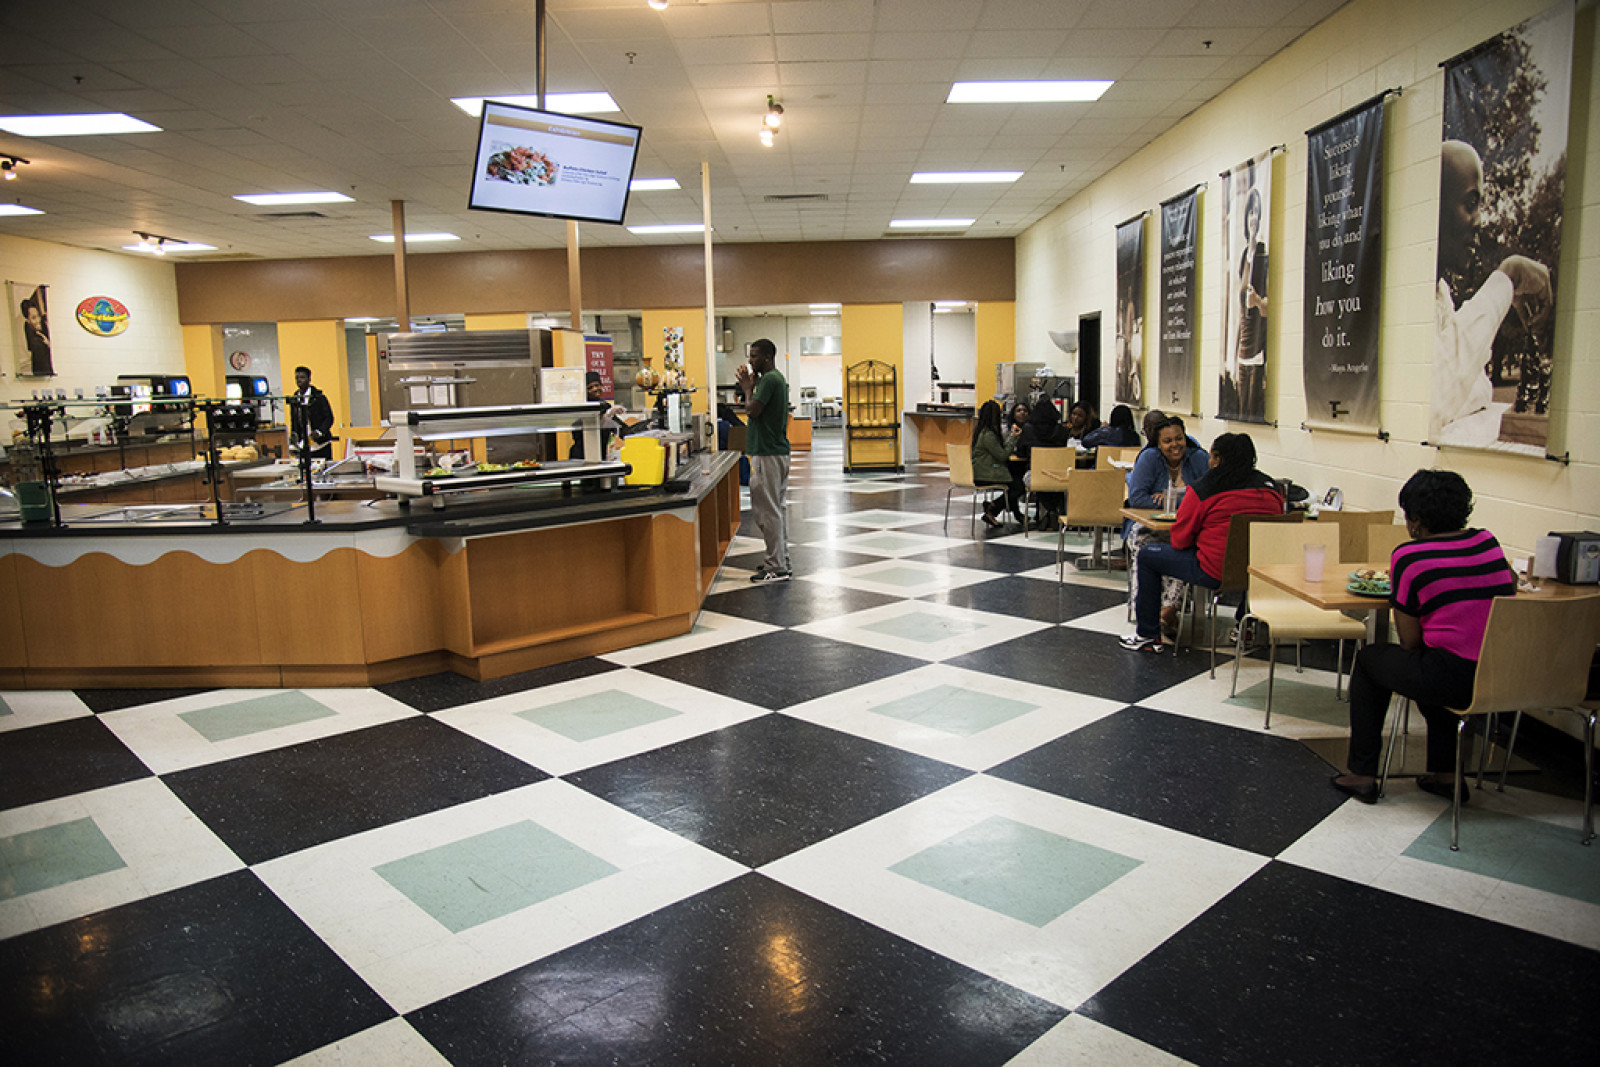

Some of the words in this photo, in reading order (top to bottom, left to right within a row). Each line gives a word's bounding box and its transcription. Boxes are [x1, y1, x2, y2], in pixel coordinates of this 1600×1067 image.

[1324, 139, 1352, 159] Success
[1353, 135, 1359, 147] is
[1329, 161, 1352, 180] liking
[1318, 211, 1342, 228] liking
[1342, 204, 1363, 220] what
[1344, 224, 1362, 244] and
[1321, 259, 1355, 284] liking
[1314, 295, 1335, 316] how
[1338, 296, 1361, 319] you
[1321, 326, 1334, 347] do
[1336, 326, 1351, 347] it.
